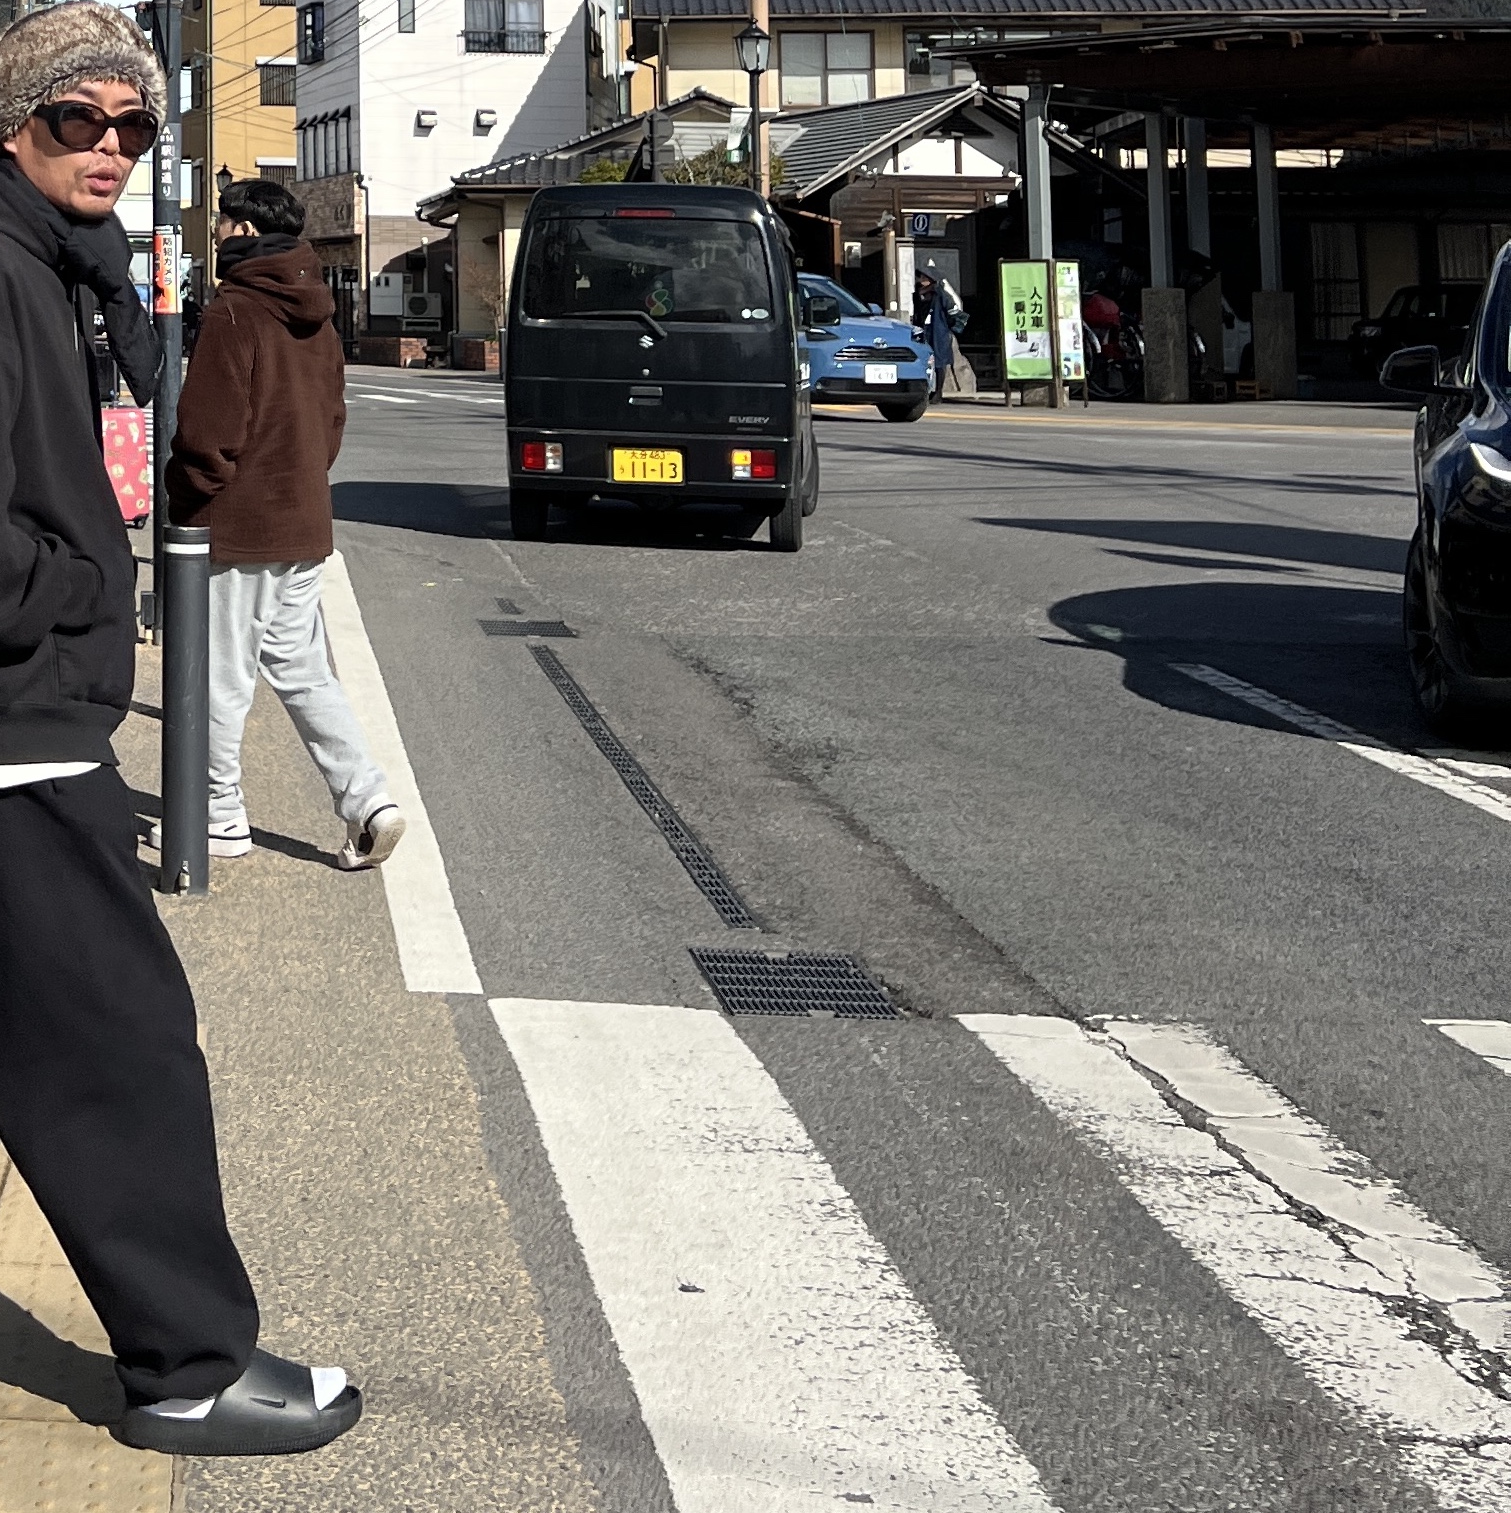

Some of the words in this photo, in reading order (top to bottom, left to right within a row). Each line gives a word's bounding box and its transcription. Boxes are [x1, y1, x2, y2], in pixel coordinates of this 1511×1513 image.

[160, 144, 175, 197] 駅前通り
[1030, 286, 1044, 328] 人力車
[728, 415, 770, 424] EVERY
[631, 461, 678, 479] 11-13
